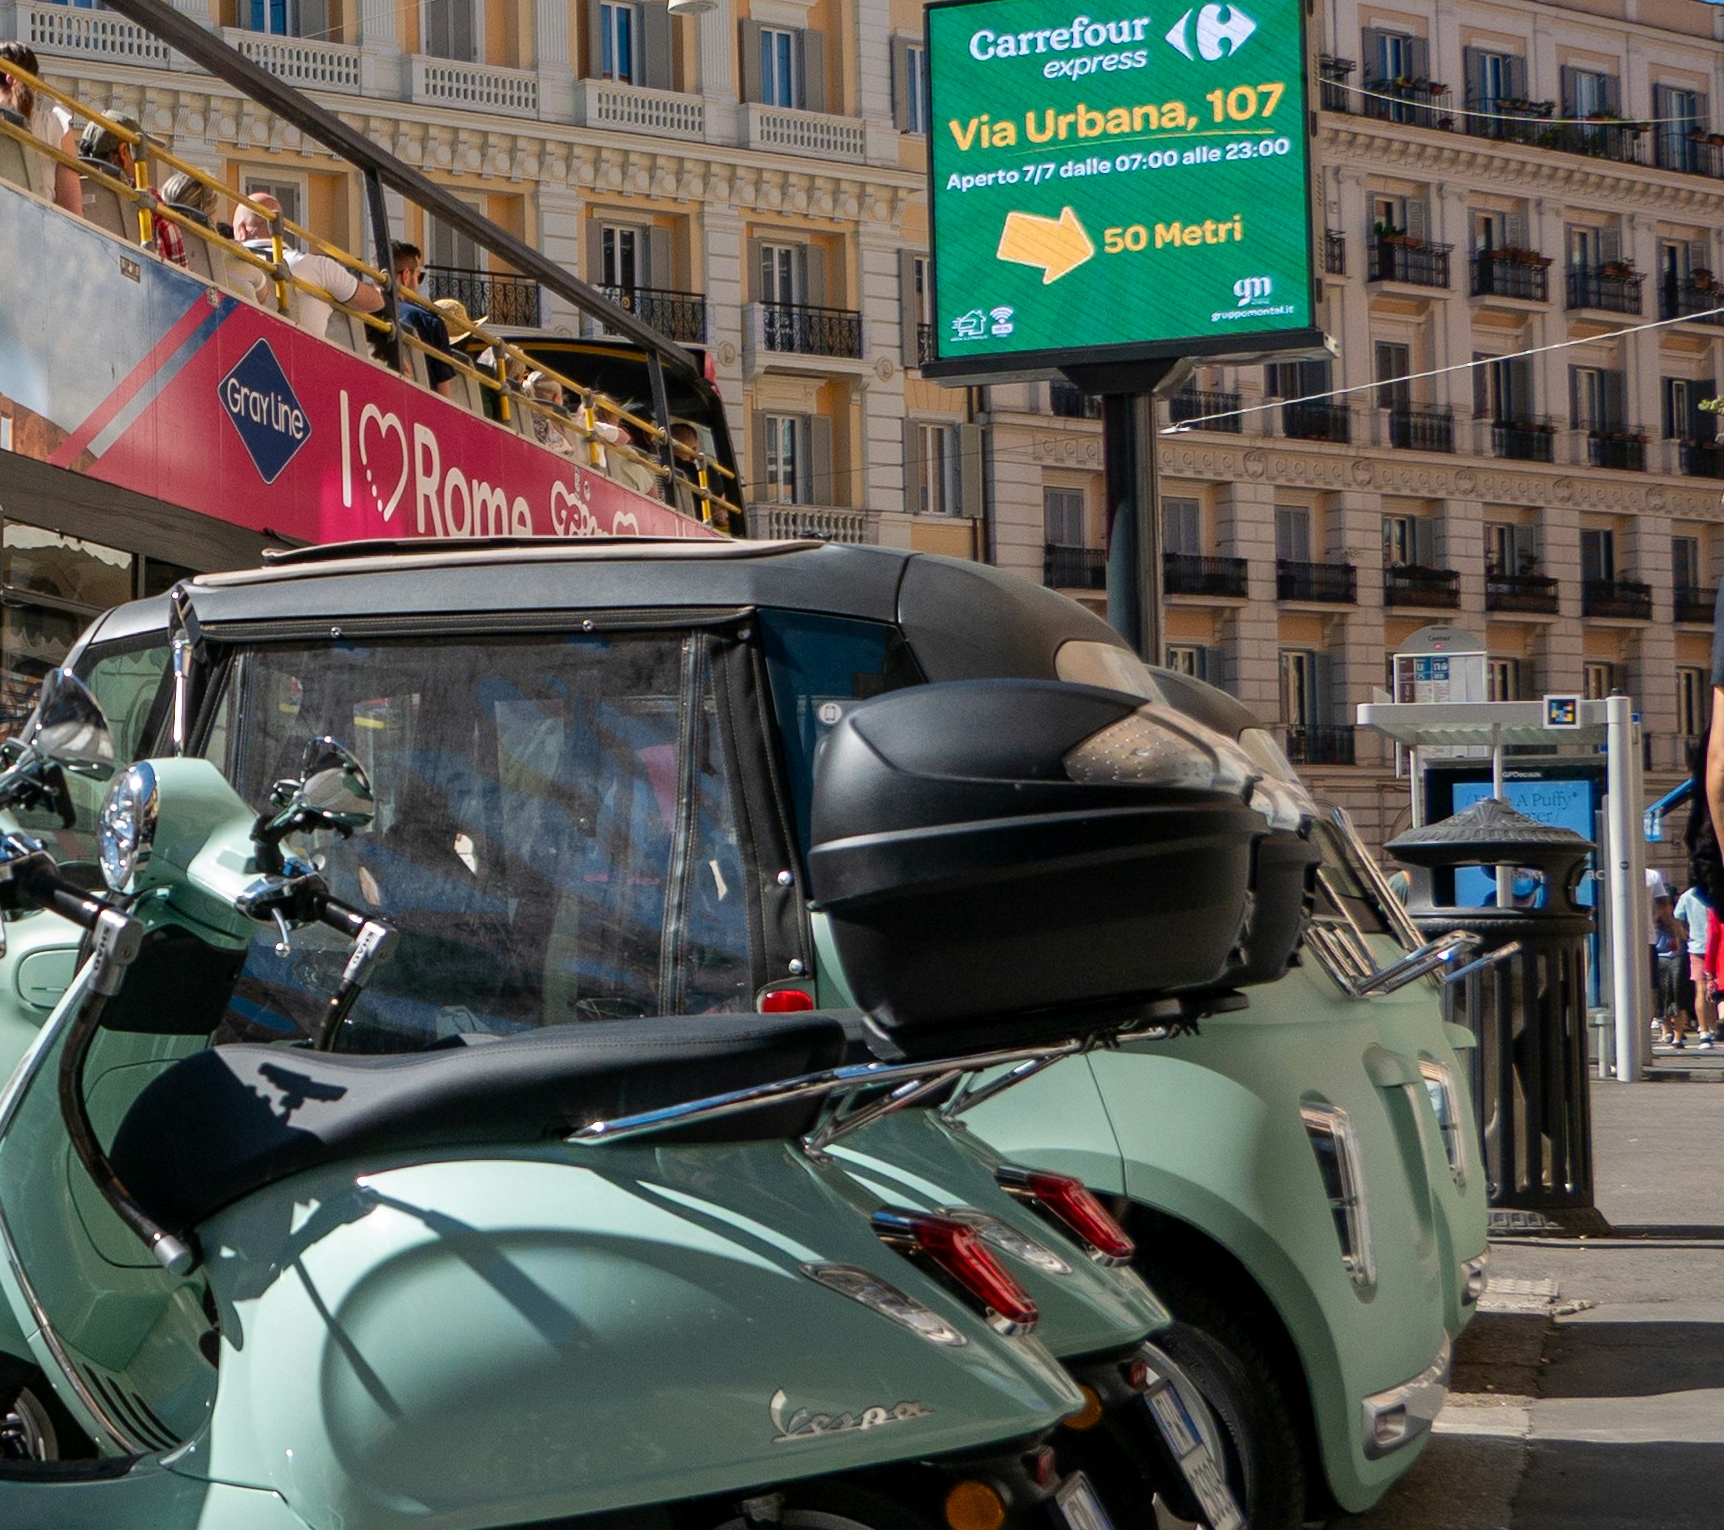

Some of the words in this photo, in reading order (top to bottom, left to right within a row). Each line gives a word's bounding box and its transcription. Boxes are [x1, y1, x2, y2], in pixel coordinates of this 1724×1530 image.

[969, 15, 1150, 61] Carrefour
[1043, 49, 1148, 81] express
[948, 114, 1018, 151] Via
[1026, 97, 1198, 144] Urbana,
[1206, 83, 1285, 123] 107
[946, 168, 1019, 192] Aperto
[1023, 164, 1056, 186] 7/7
[1059, 157, 1111, 179] dalle
[1115, 151, 1178, 173] 07:00
[1182, 146, 1221, 165] alle
[1225, 138, 1290, 160] 23:00
[1104, 225, 1147, 254] 50
[1155, 215, 1243, 250] Metri
[340, 390, 352, 508] I
[414, 424, 532, 537] Rome
